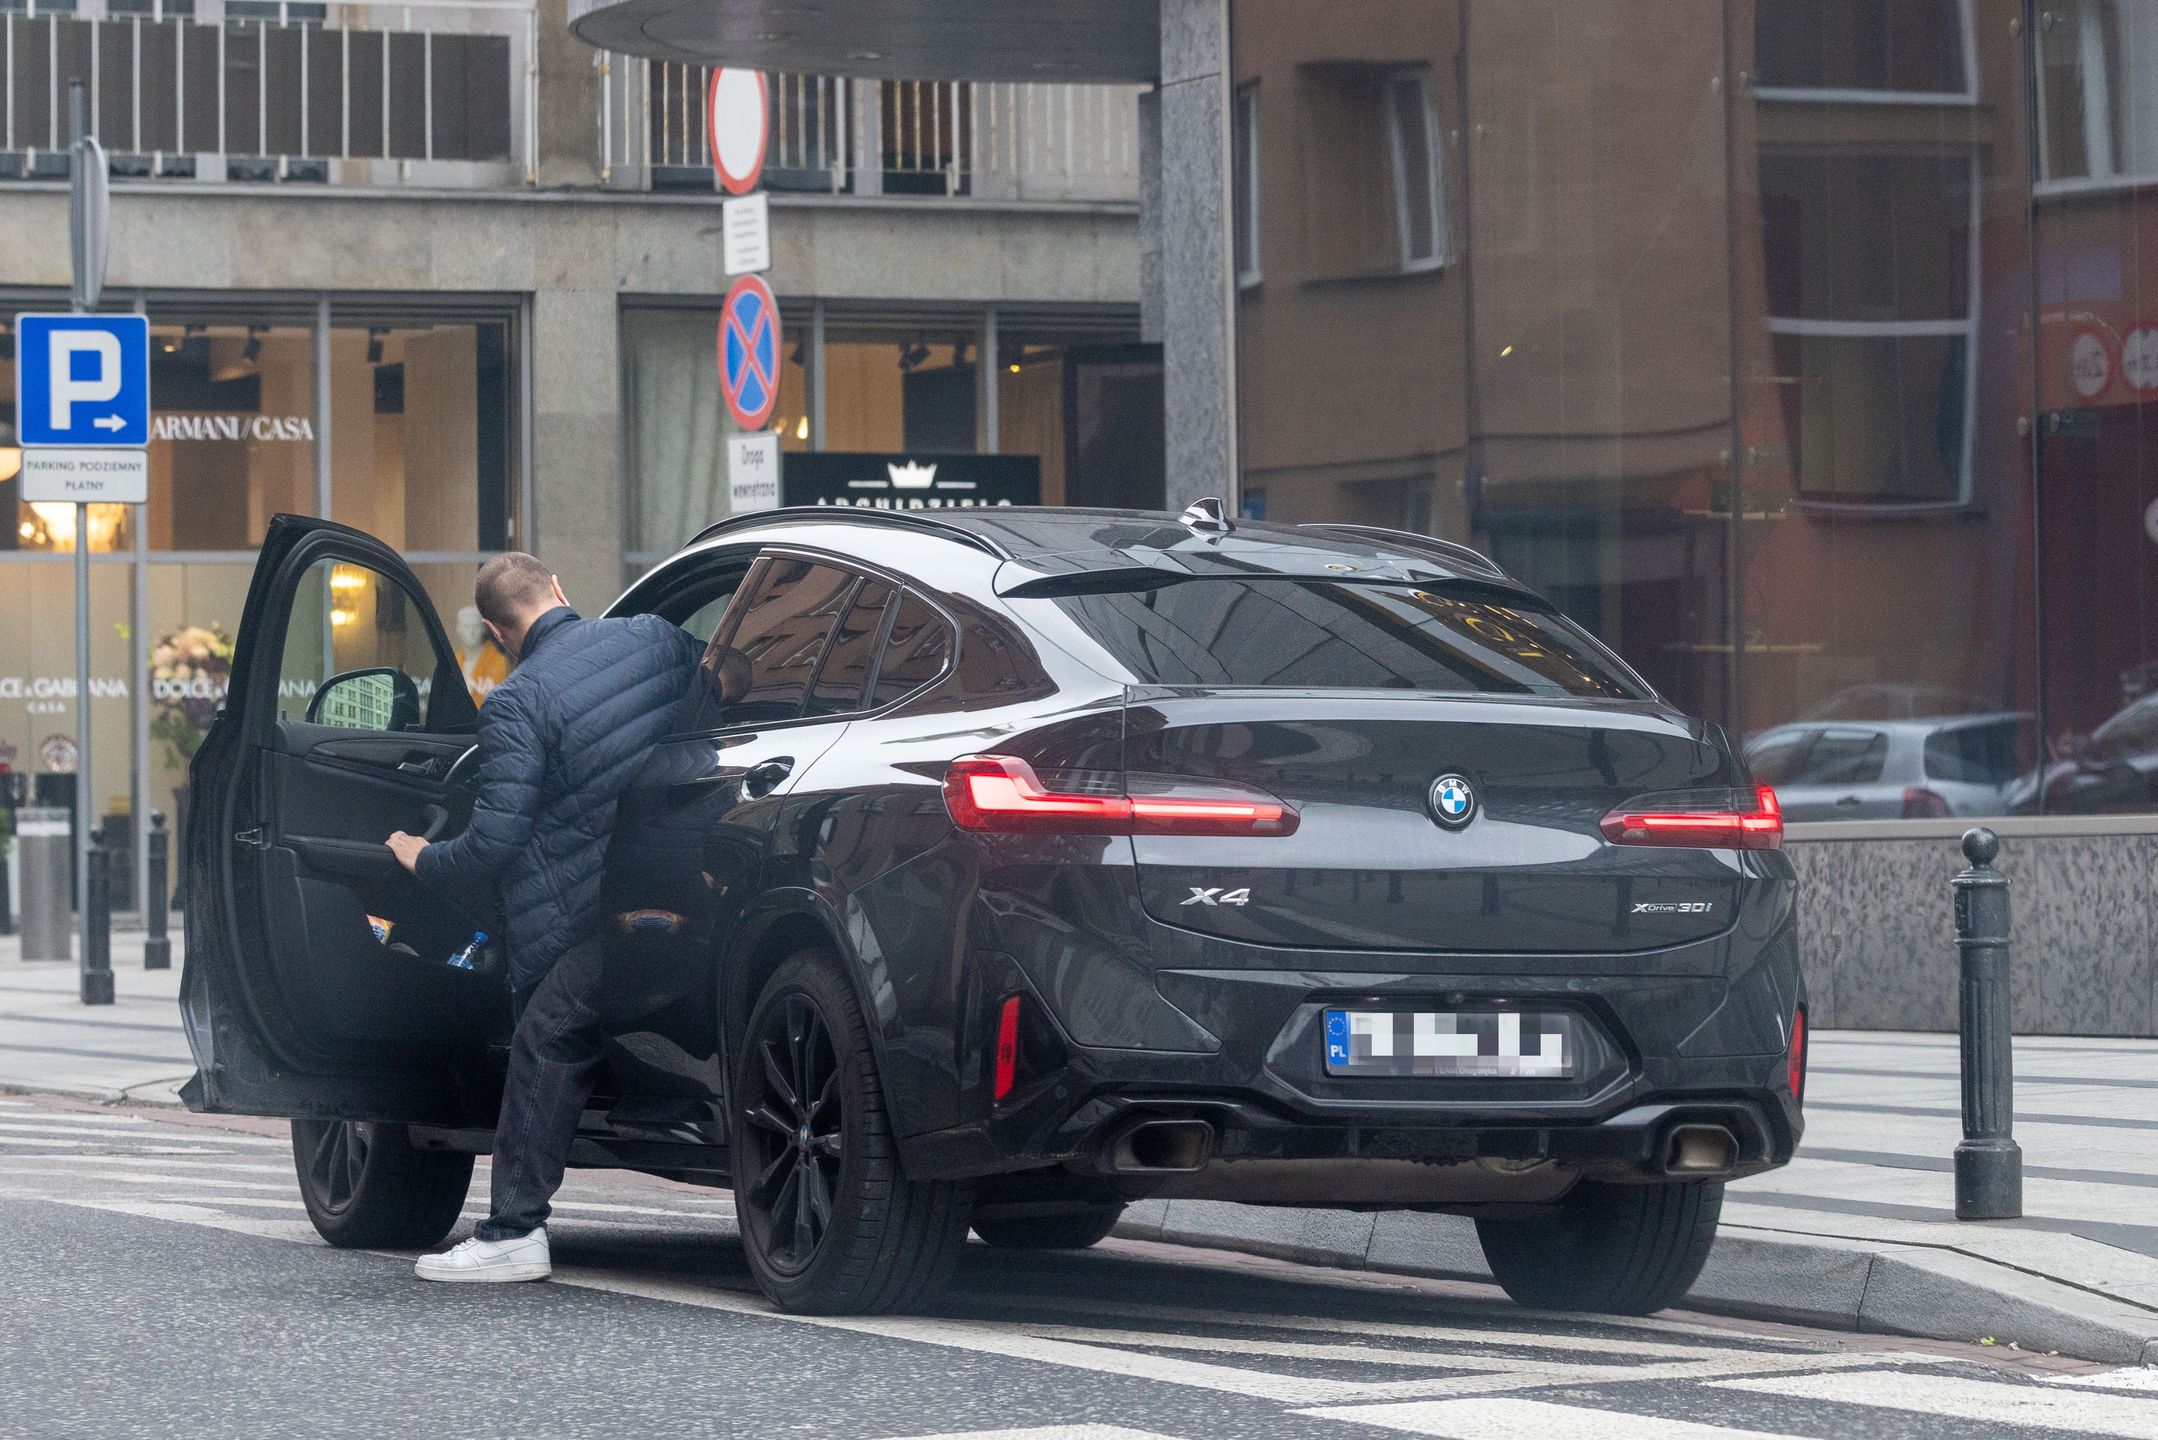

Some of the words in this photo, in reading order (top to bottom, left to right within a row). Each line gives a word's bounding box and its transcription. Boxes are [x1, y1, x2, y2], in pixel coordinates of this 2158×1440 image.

[49, 329, 122, 430] P
[27, 461, 76, 472] PARKING
[79, 461, 142, 472] PODZIEMNY
[1436, 780, 1470, 794] BMW
[1179, 887, 1251, 906] X4
[1678, 903, 1713, 912] 30i
[1330, 1044, 1347, 1058] PL
